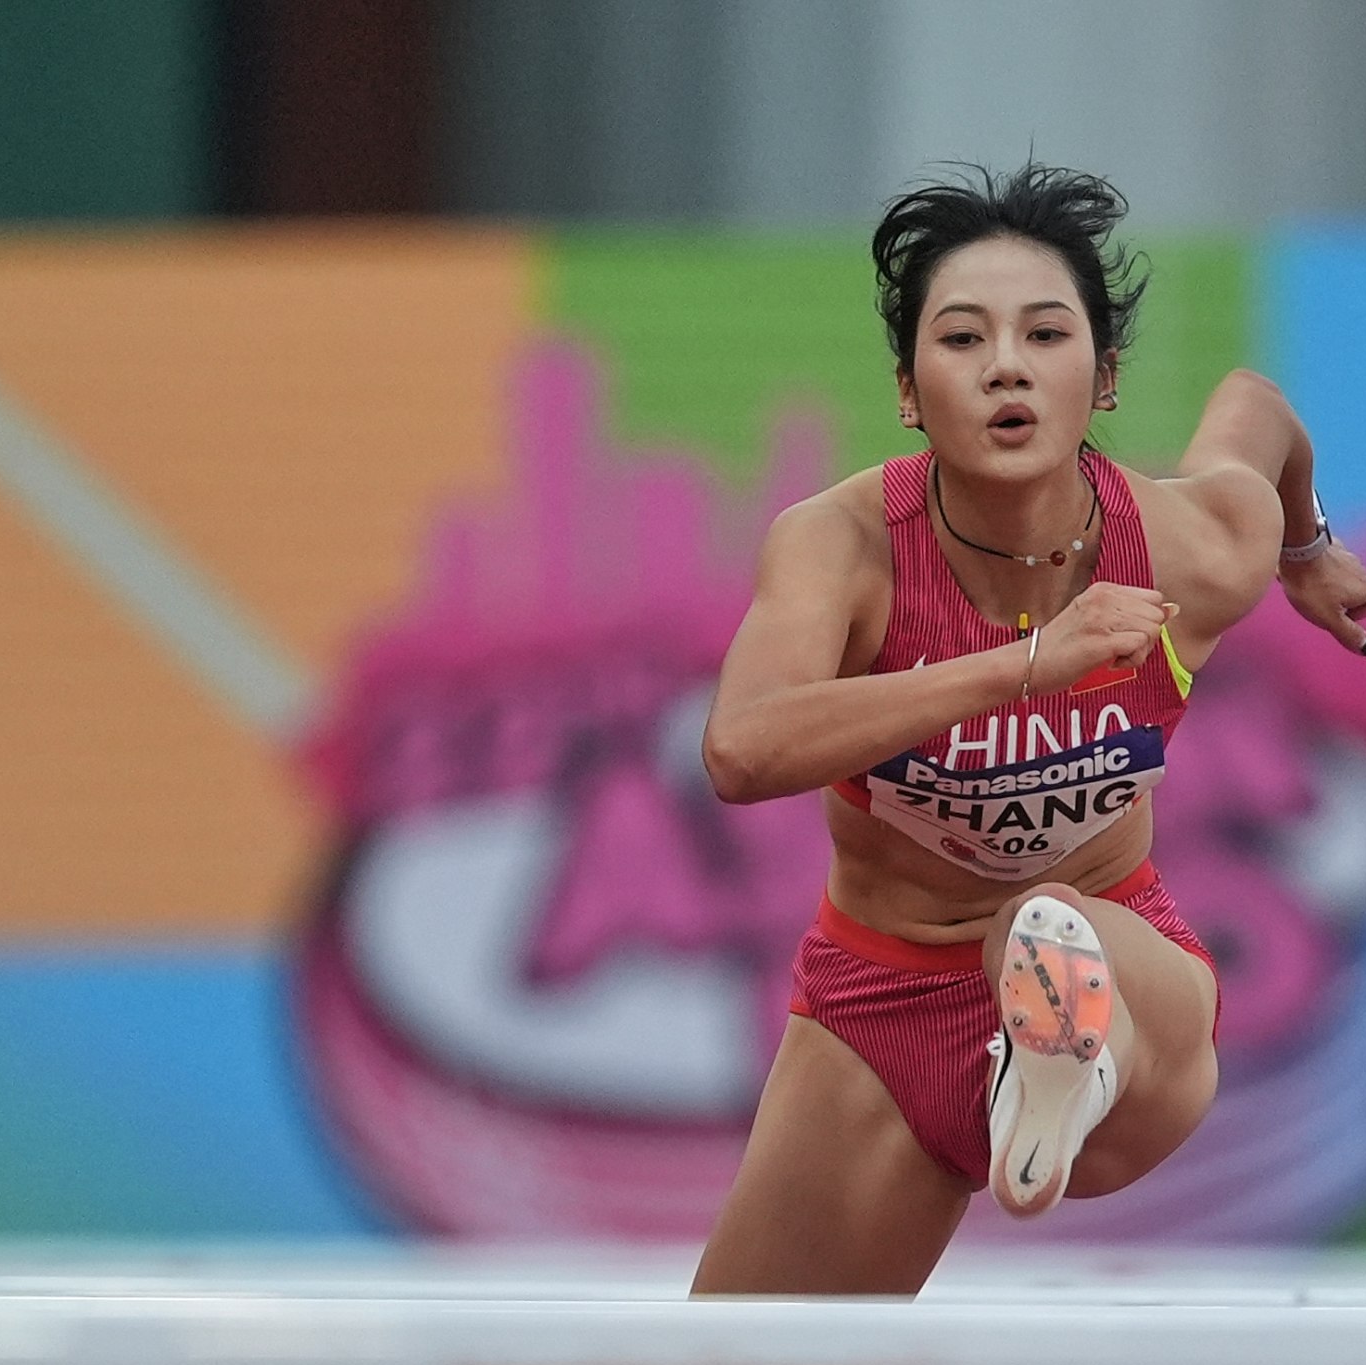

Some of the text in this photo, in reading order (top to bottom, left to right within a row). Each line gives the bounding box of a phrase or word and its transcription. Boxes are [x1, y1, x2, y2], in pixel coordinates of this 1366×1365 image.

[928, 703, 1132, 770] HINA
[905, 746, 1131, 798] Panasonic
[895, 780, 1139, 835] ZHANG
